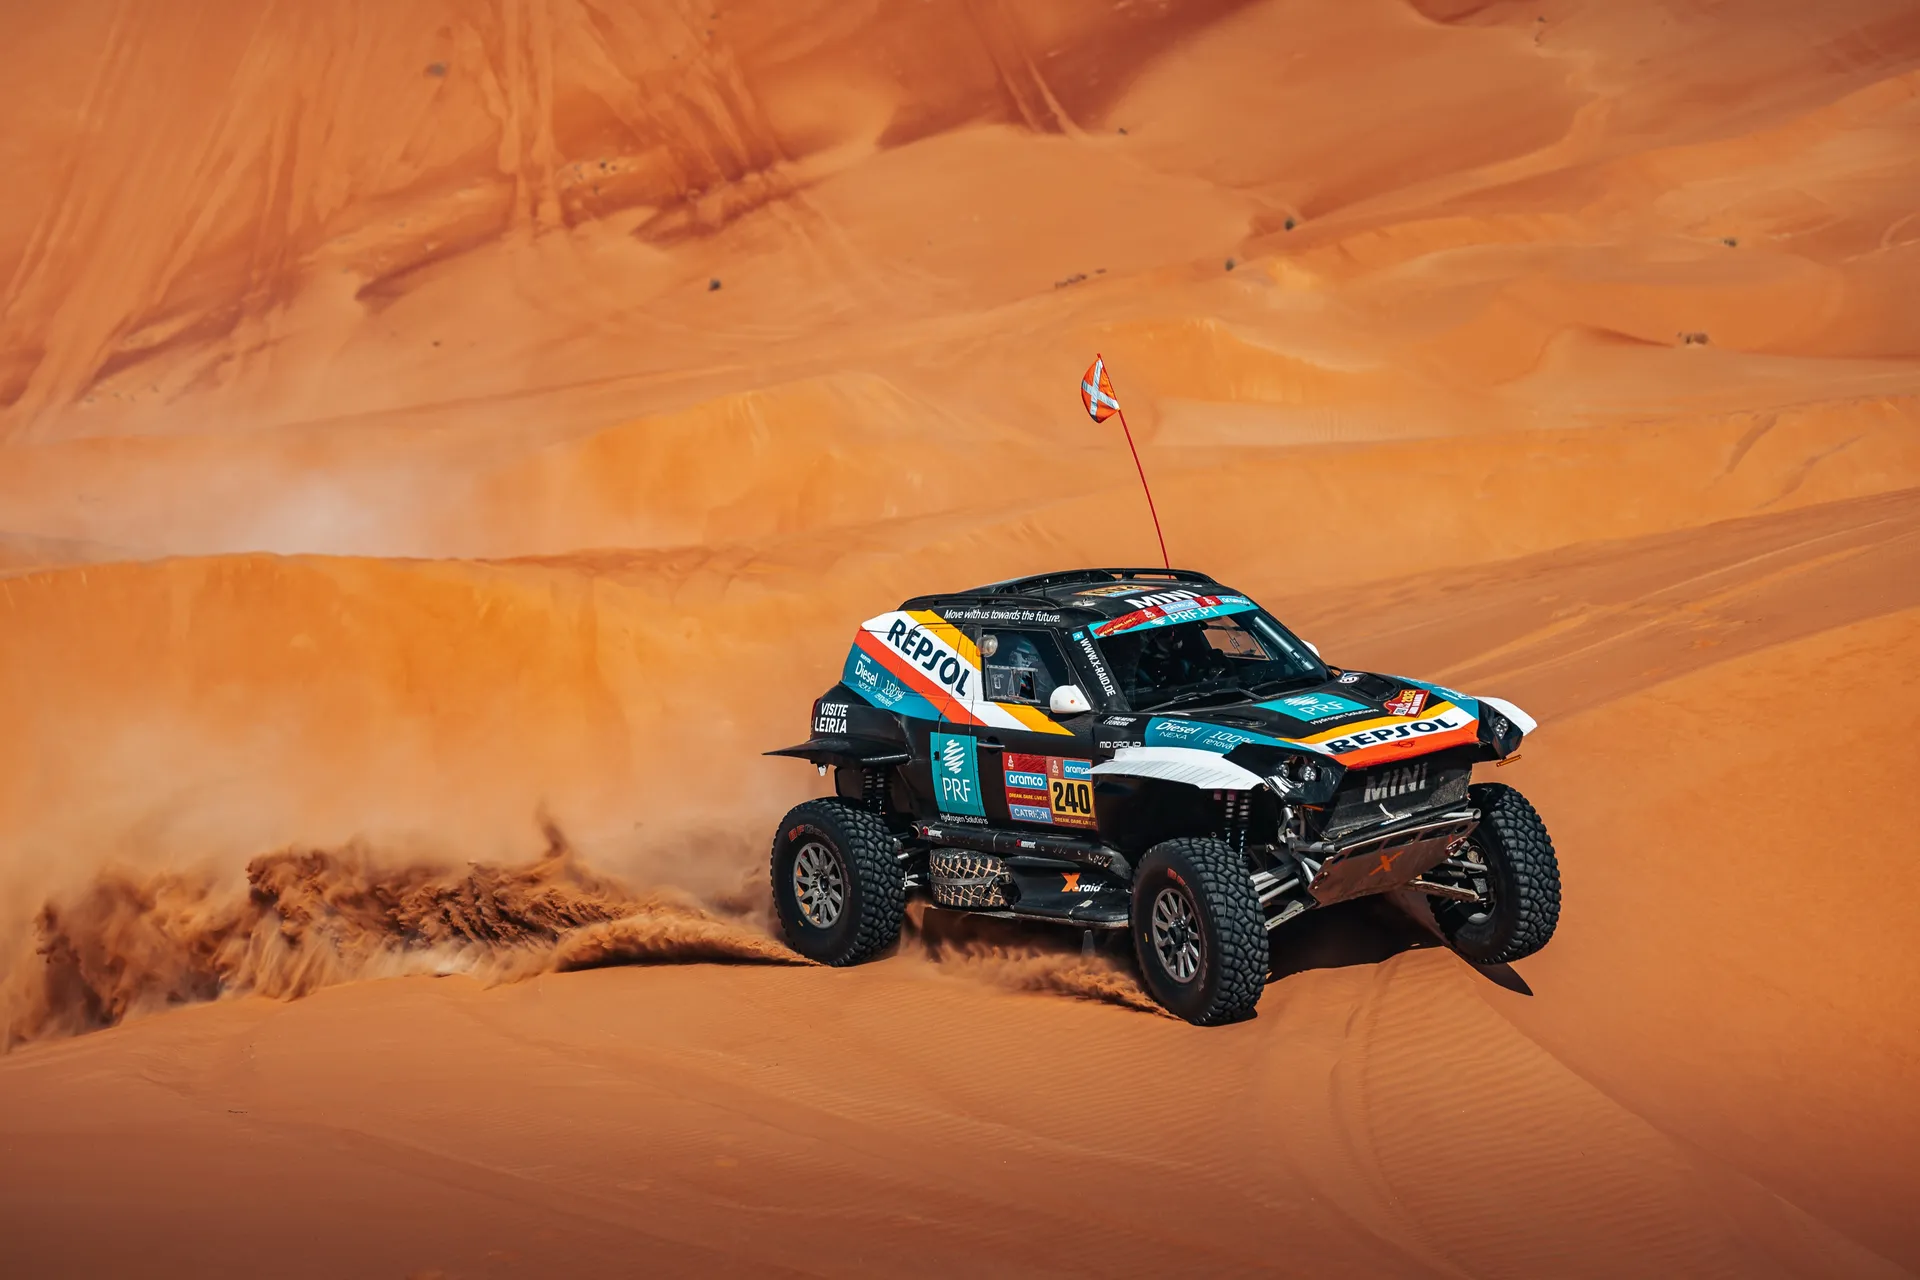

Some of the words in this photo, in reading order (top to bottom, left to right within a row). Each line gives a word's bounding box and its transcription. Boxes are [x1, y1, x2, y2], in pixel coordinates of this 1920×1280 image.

[1125, 590, 1201, 609] MINI
[944, 609, 963, 619] Move
[964, 608, 981, 618] with
[991, 609, 1020, 620] towards
[1021, 610, 1035, 620] the
[1035, 611, 1060, 622] future.
[1168, 605, 1220, 622] PRF.PT
[887, 618, 971, 697] REPSOL
[854, 659, 878, 687] Diesel
[1080, 637, 1116, 697] WWW.X-RAID.DE
[820, 702, 848, 717] VISITE
[1298, 700, 1345, 716] PRF
[1310, 714, 1346, 725] Hydrogen
[1345, 708, 1379, 718] Solutions
[814, 716, 847, 734] LEIRIA
[1155, 721, 1202, 735] Diesel
[1159, 731, 1188, 740] NEXA
[1326, 717, 1458, 754] REPSOL
[1009, 774, 1043, 787] aramco
[1364, 762, 1428, 803] MINI
[942, 777, 971, 802] PRF
[1053, 781, 1091, 814] 240
[939, 812, 965, 824] Hydrogen
[1014, 808, 1048, 820] CATRION
[1061, 872, 1102, 892] X-raid
